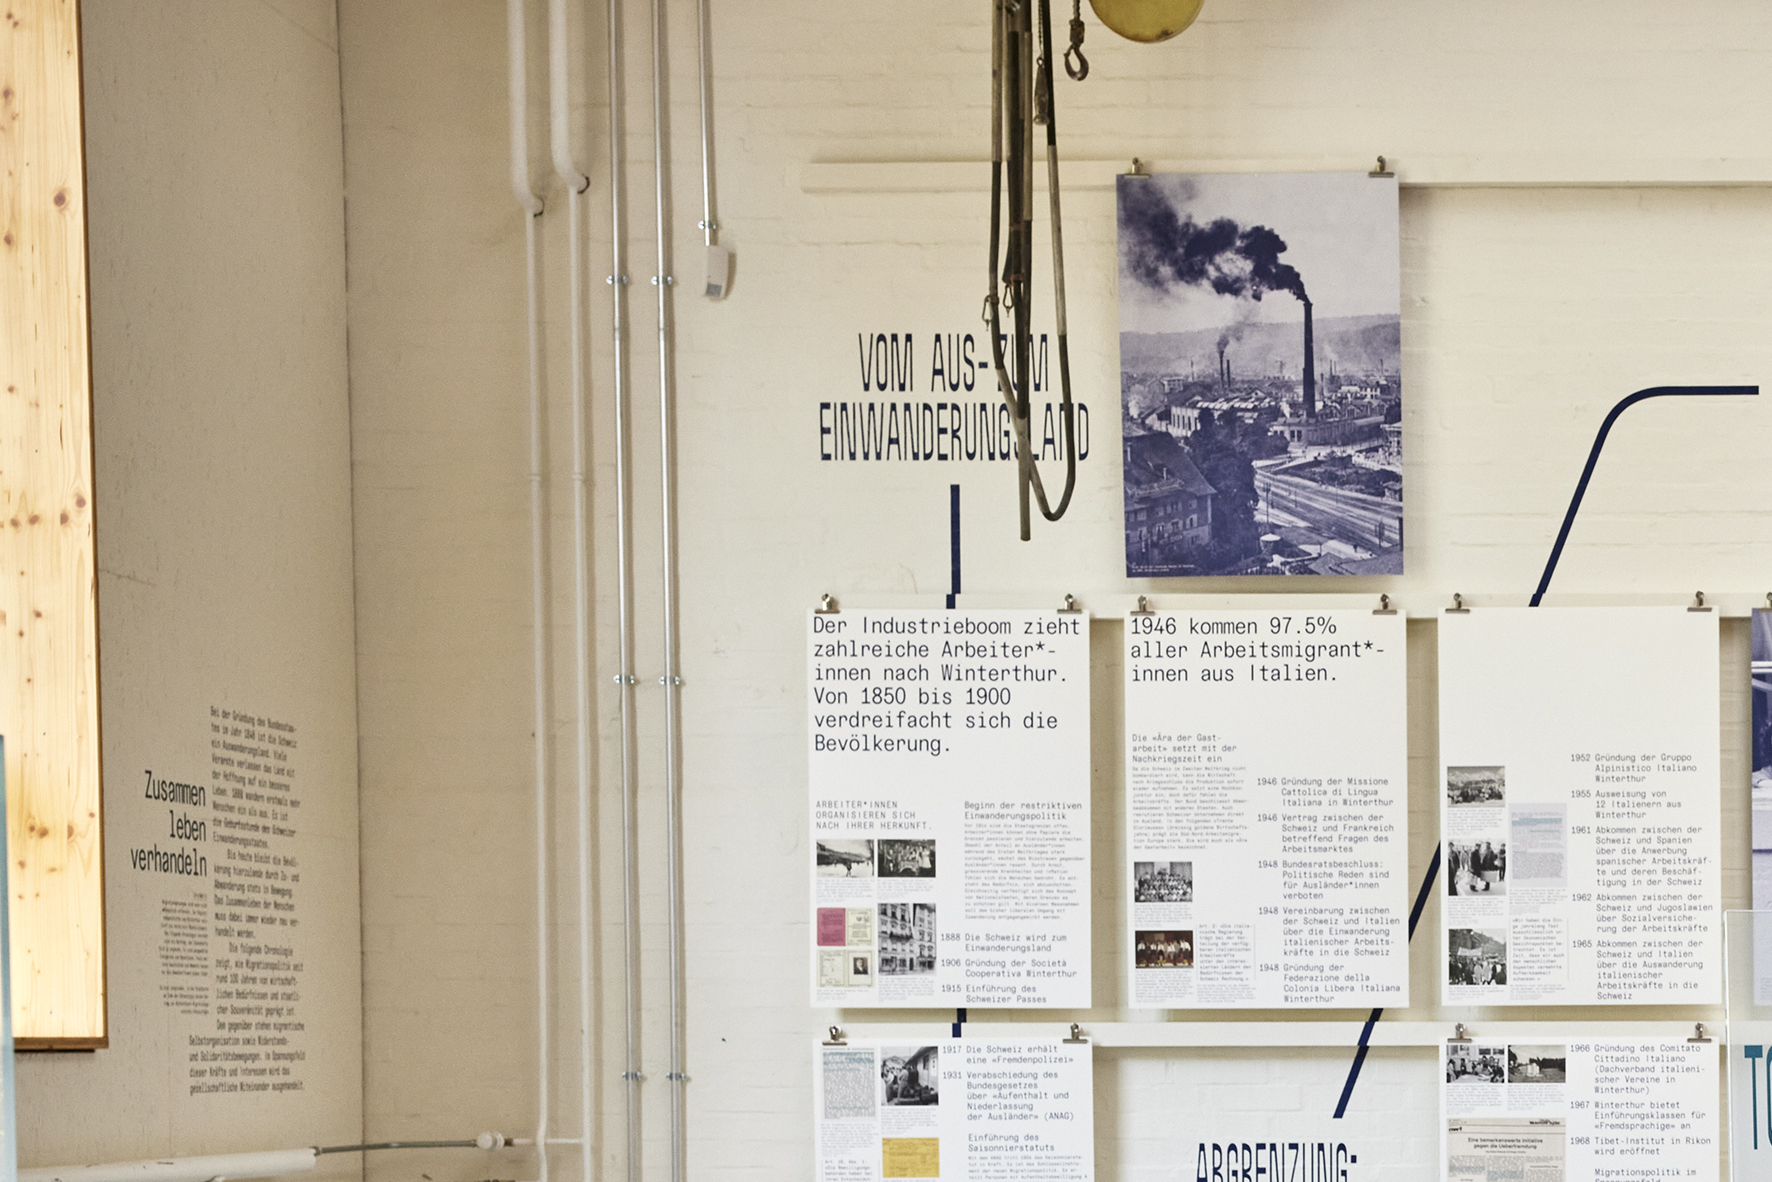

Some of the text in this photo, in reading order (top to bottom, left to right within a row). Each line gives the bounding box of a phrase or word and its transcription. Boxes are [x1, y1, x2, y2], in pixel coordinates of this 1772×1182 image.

[859, 333, 913, 392] VOM
[931, 333, 989, 392] AUS-
[813, 613, 1082, 635] Der Industrieboom zieht
[1130, 614, 1337, 635] 1946 kommen 97.5%
[814, 639, 929, 658] zahlreiche
[1131, 640, 1188, 659] aller
[815, 663, 1066, 682] innen nach Winterthur.
[1133, 663, 1336, 682] innen aus Italien.
[814, 686, 1011, 705] Von 1850 bis 1900
[814, 710, 1058, 729] verdreifacht sich die
[815, 734, 949, 757] Bevölkerung.
[144, 769, 206, 807] Zusammen
[1571, 789, 1591, 798] 1955
[1595, 790, 1646, 800] Ausweisung
[815, 811, 916, 819] ORGANISIEREN SICH
[169, 809, 206, 841] leben
[816, 821, 932, 830] NACH IHRER HERKUNFT.
[1282, 845, 1353, 853] Arbeitsmarktes
[130, 844, 207, 877] verhandeln
[1570, 1136, 1590, 1145] 1968
[1595, 1136, 1665, 1145] Tibet-Institut
[1685, 1136, 1711, 1145] Rikon
